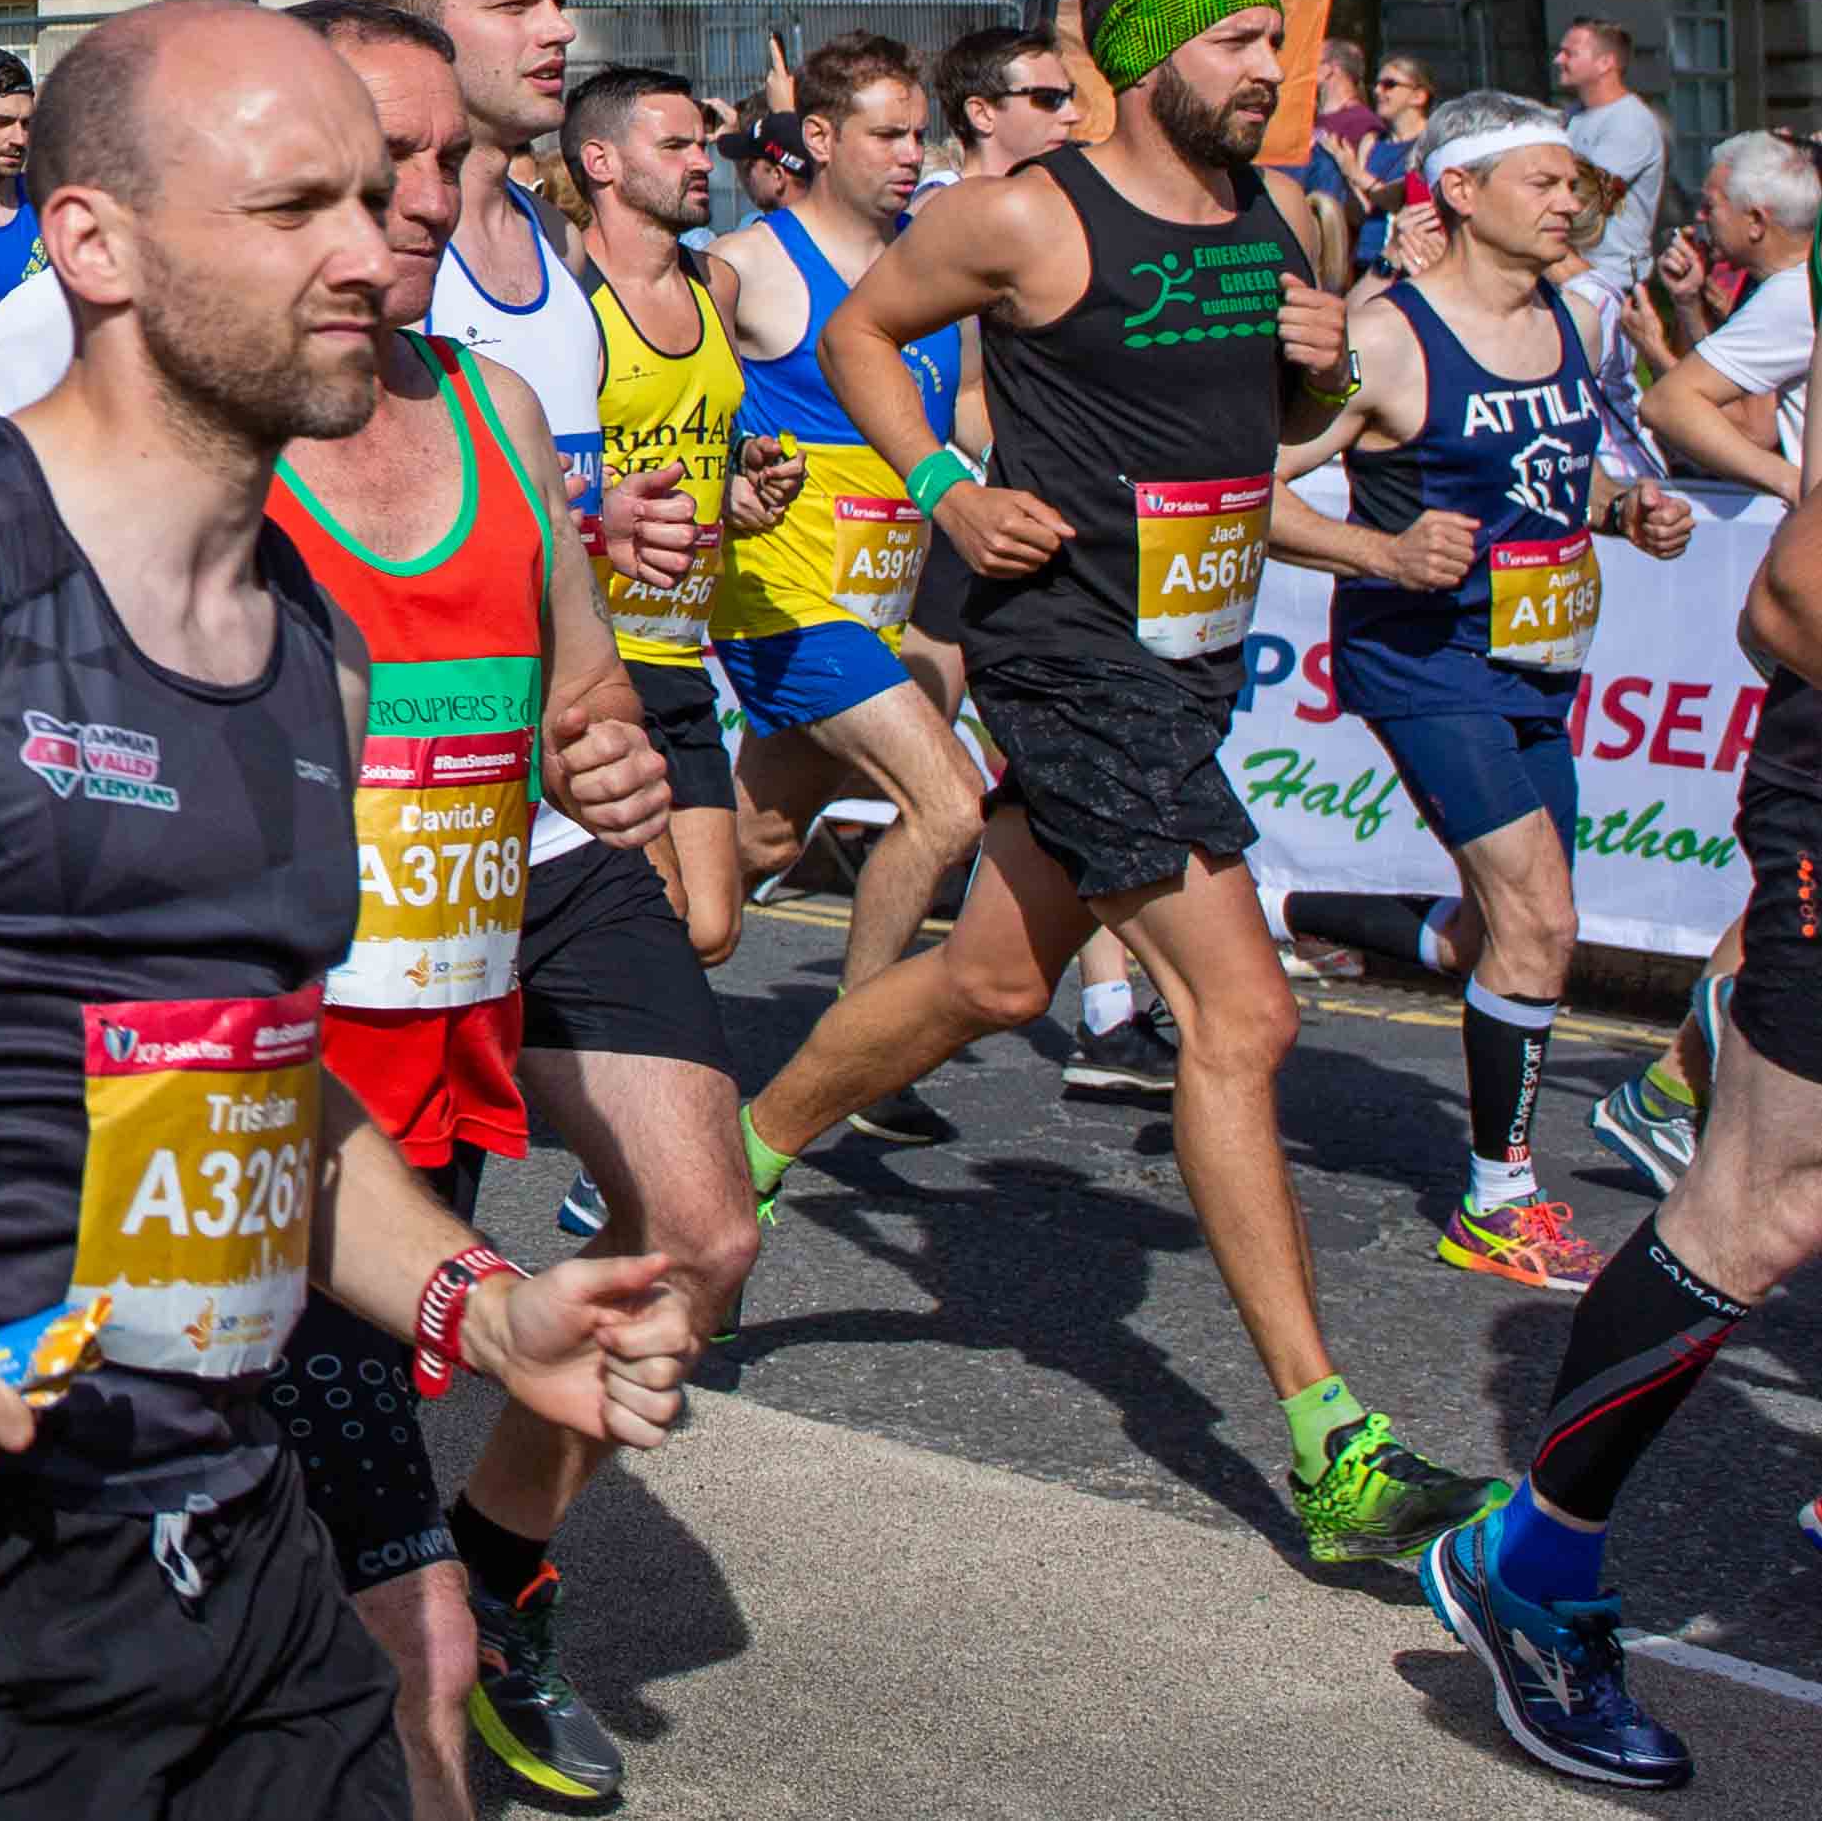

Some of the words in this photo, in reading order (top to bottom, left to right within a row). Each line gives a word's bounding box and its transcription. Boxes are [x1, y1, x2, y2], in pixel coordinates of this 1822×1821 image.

[1193, 242, 1284, 268] EMERSONS
[1220, 270, 1278, 293] GREEN
[1462, 379, 1600, 438] ATTILA
[603, 394, 731, 453] Run4A
[886, 530, 911, 545] Paul
[1209, 522, 1247, 544] Jack
[1160, 530, 1265, 595] A5613
[85, 751, 154, 777] VALLEY
[361, 764, 415, 780] Solicitors
[89, 780, 177, 809] KENYANS
[1242, 747, 1399, 842] Half
[357, 836, 521, 908] A3768
